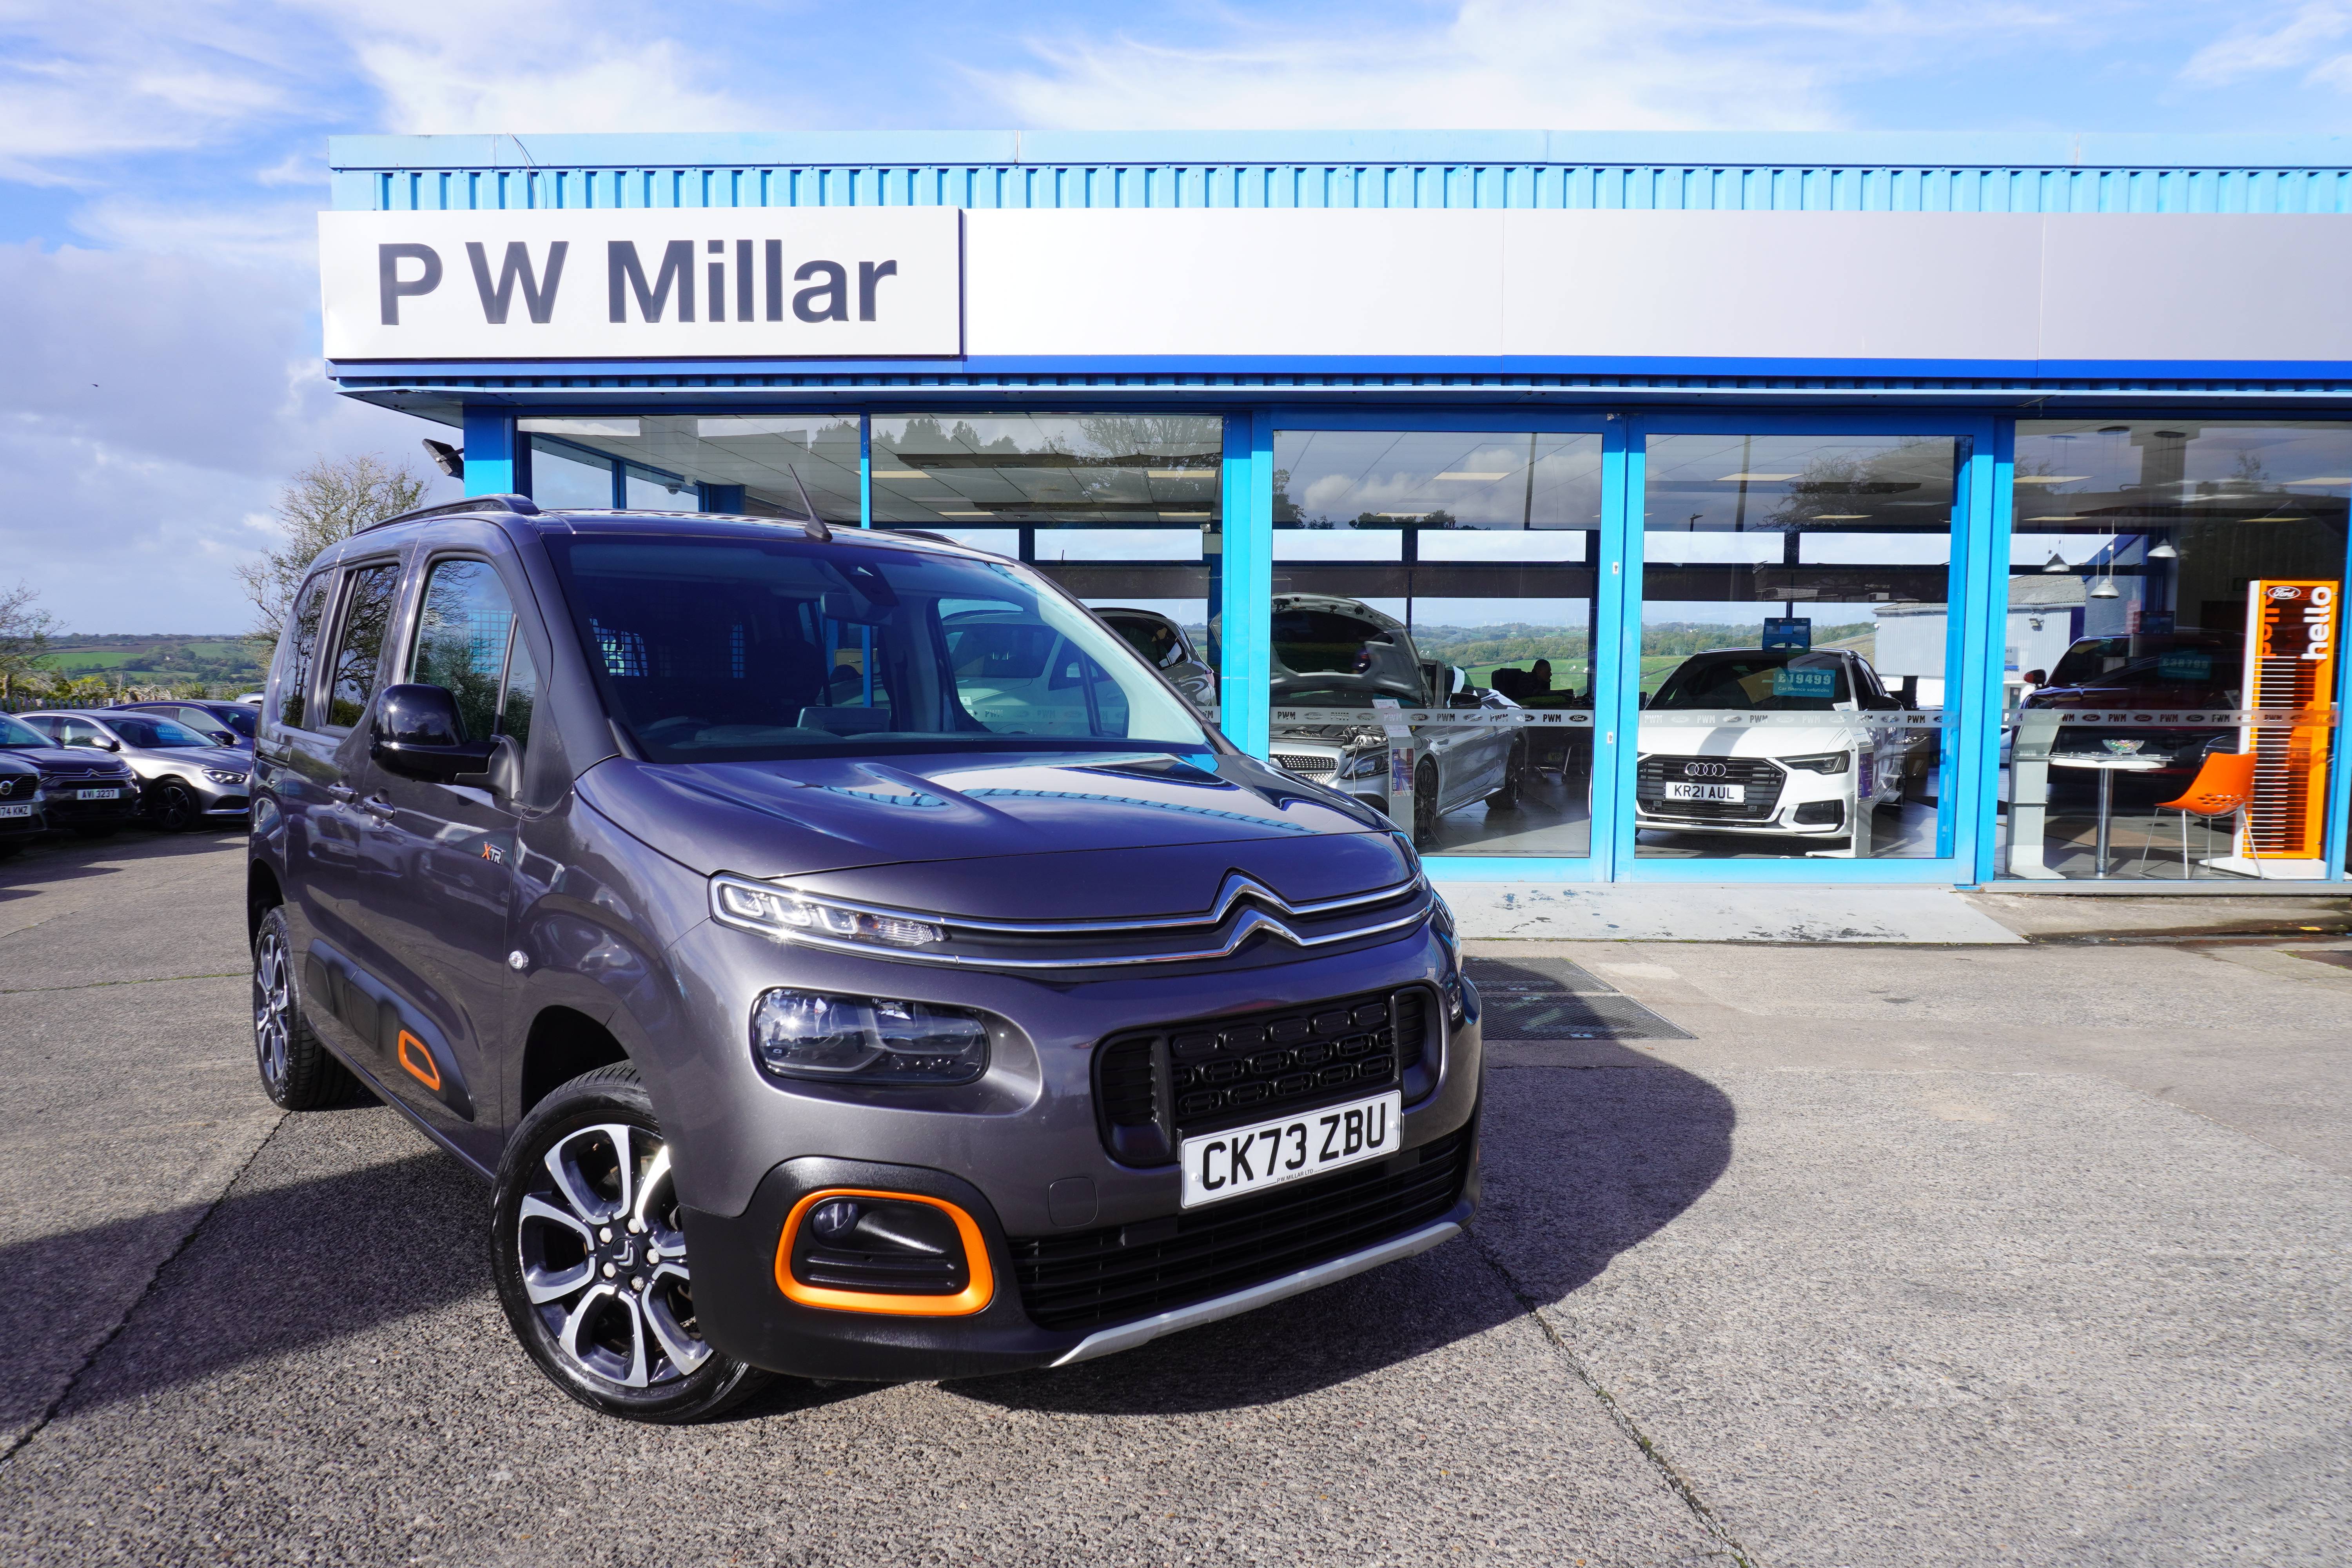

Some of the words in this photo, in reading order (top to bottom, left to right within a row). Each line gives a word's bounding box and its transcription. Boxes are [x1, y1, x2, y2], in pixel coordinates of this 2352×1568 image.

[379, 243, 443, 326] P
[465, 241, 569, 324] W
[608, 239, 897, 323] Millar
[2273, 587, 2296, 597] Ford
[2300, 586, 2332, 659] hello
[1778, 673, 1831, 685] £19499
[1278, 711, 1296, 720] PWM
[1384, 713, 1402, 721] PWM
[1437, 713, 1455, 722] PWM
[1490, 714, 1508, 722] PWM
[1543, 714, 1561, 722] PWM
[1644, 715, 1662, 724] PWM
[1697, 715, 1715, 724] PWM
[1750, 715, 1768, 724] PWM
[1802, 715, 1820, 724] PWM
[1907, 715, 1926, 724] PWM
[2057, 713, 2074, 722] PWM
[2108, 714, 2127, 722] PWM
[2160, 714, 2178, 722] PWM
[2212, 714, 2230, 722] PWM
[82, 790, 94, 799] AVI
[96, 789, 115, 798] 3237
[1675, 784, 1704, 798] KR21
[1708, 786, 1735, 799] AUL
[0, 807, 11, 816] 74
[13, 806, 28, 815] KMZ
[481, 842, 502, 864] XTR
[1202, 1123, 1307, 1191] CK73
[1319, 1102, 1386, 1163] ZBU
